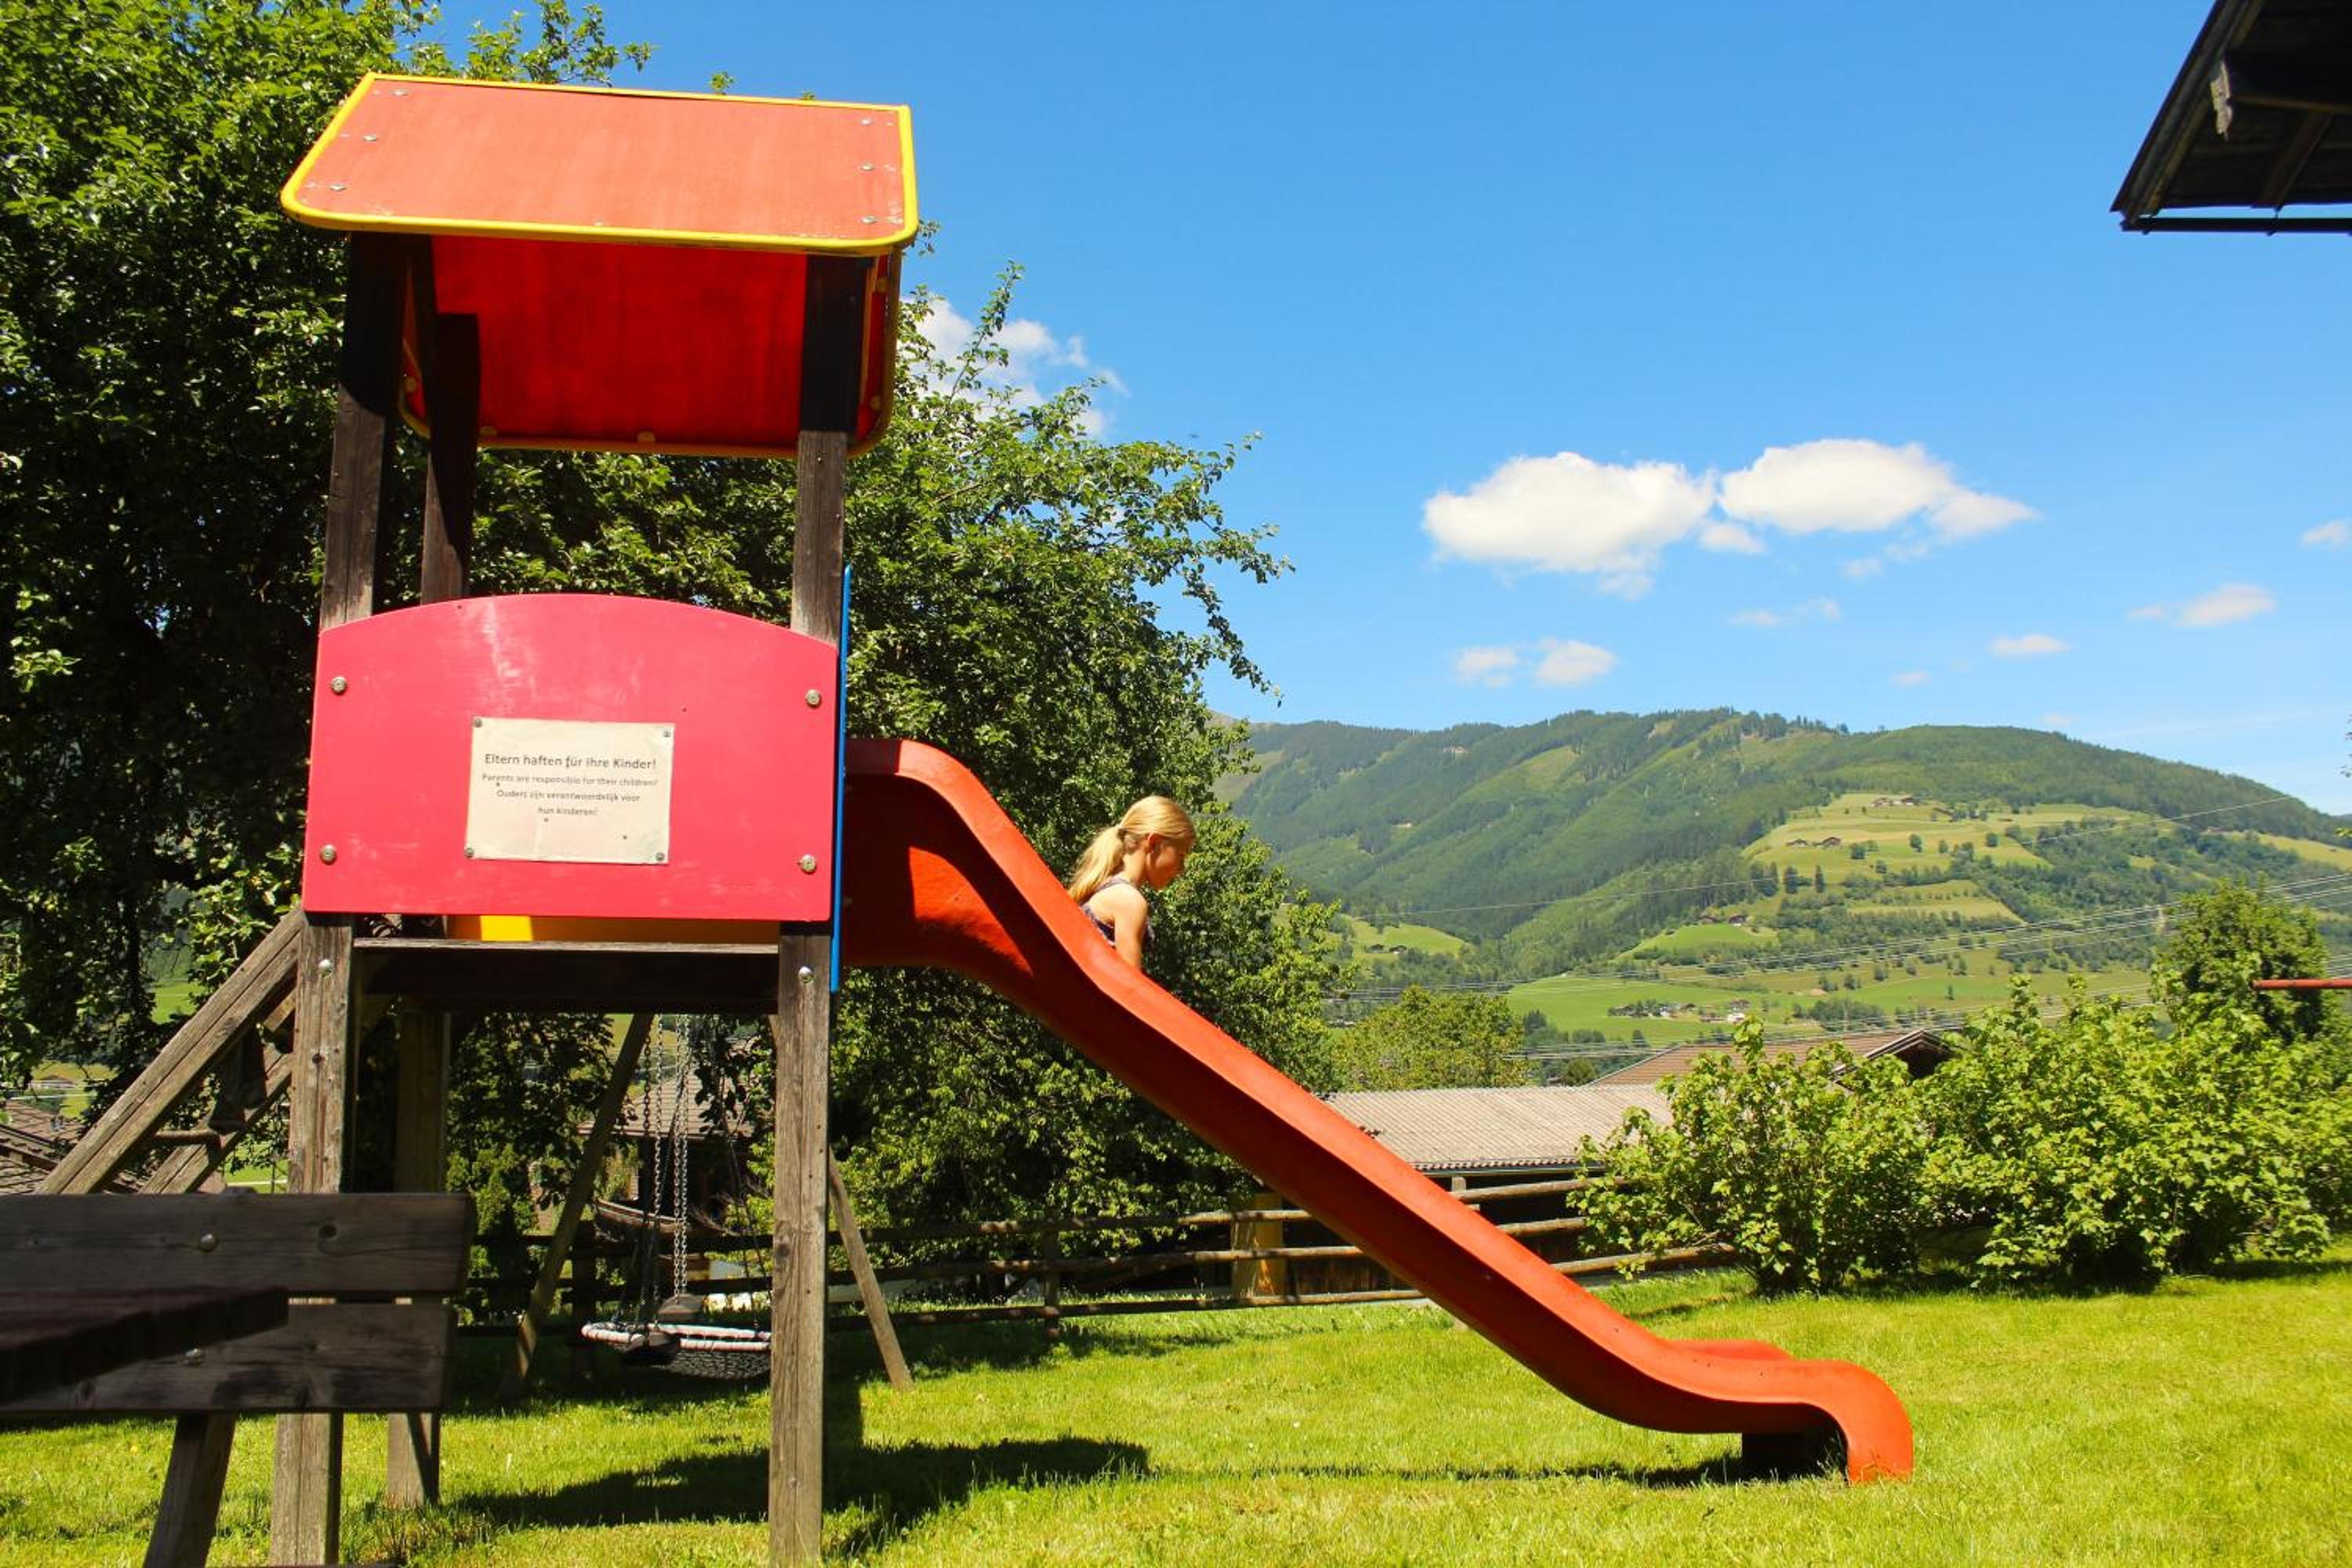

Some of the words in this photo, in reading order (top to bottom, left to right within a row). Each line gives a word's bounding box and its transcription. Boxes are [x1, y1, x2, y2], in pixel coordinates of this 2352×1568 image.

[485, 753, 520, 764] Eltern
[523, 755, 562, 767] haften
[565, 755, 583, 768] für
[613, 758, 657, 769] Kinder!
[482, 774, 514, 782] Parents
[532, 776, 580, 786] responsible
[597, 777, 617, 786] their
[496, 789, 527, 799] Ouders
[547, 791, 618, 803] verantwoordelijk
[538, 807, 554, 815] hun
